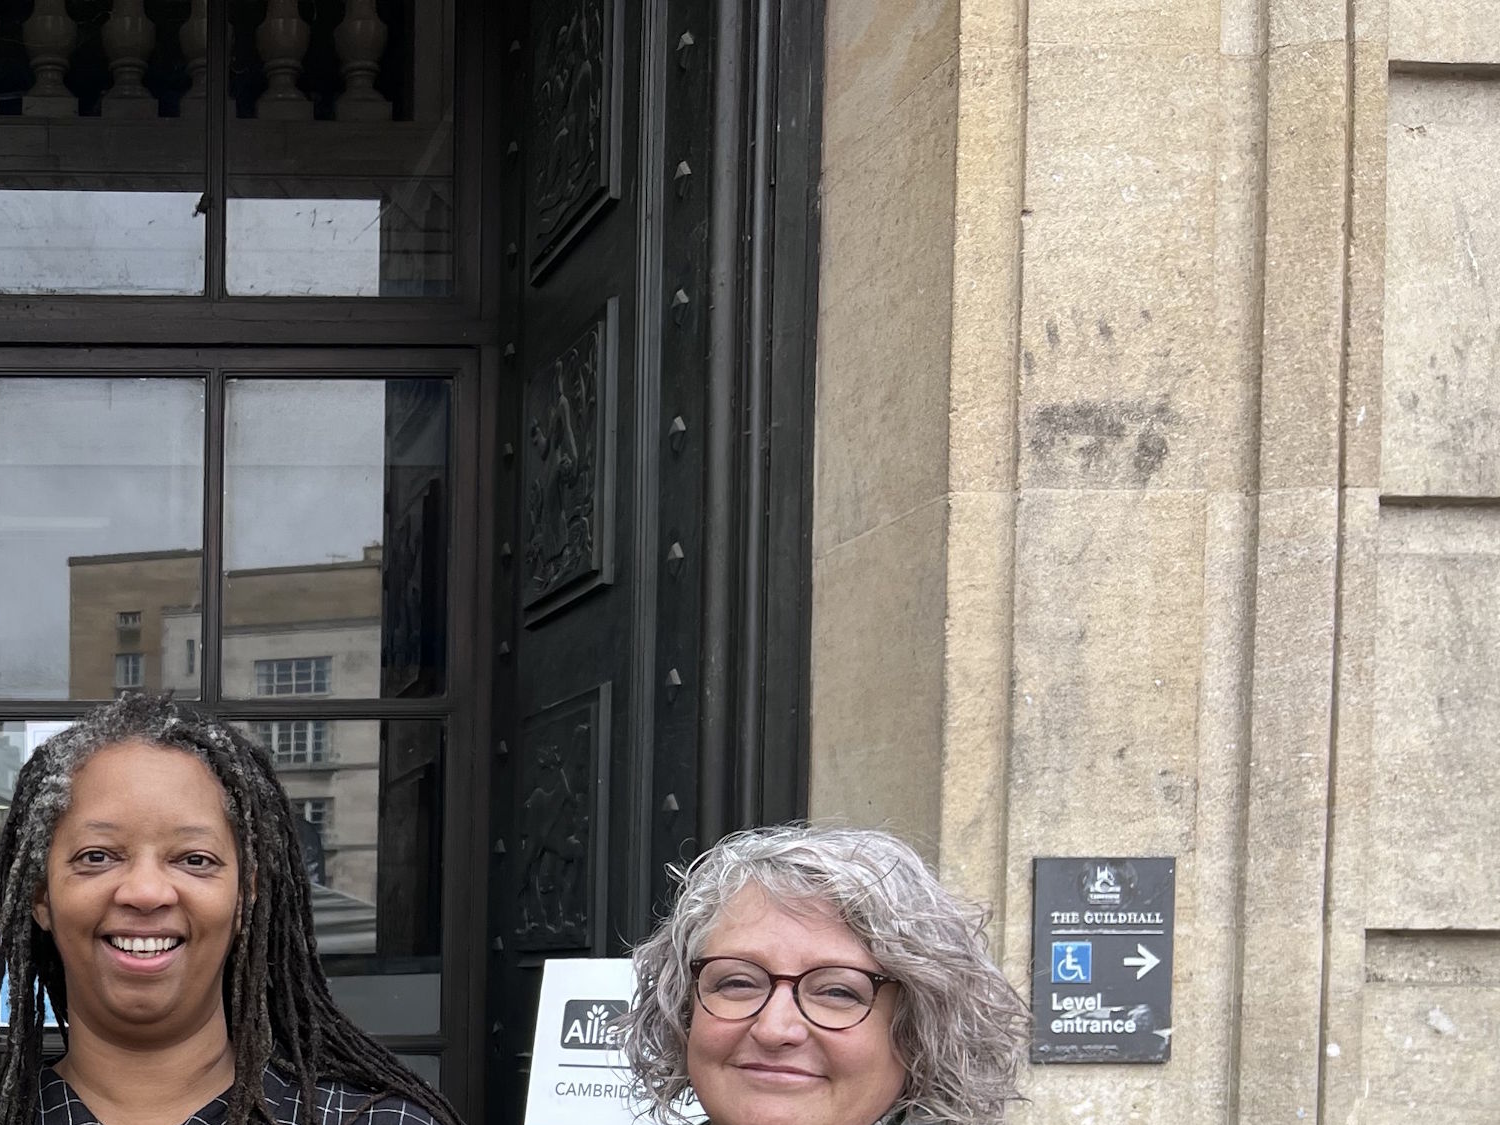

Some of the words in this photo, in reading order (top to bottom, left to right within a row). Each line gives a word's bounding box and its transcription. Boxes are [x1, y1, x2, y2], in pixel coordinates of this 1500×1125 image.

[1051, 911, 1080, 924] THE
[1084, 911, 1164, 924] GUILDHALL
[1051, 993, 1102, 1011] Level
[1051, 1018, 1137, 1034] entrance
